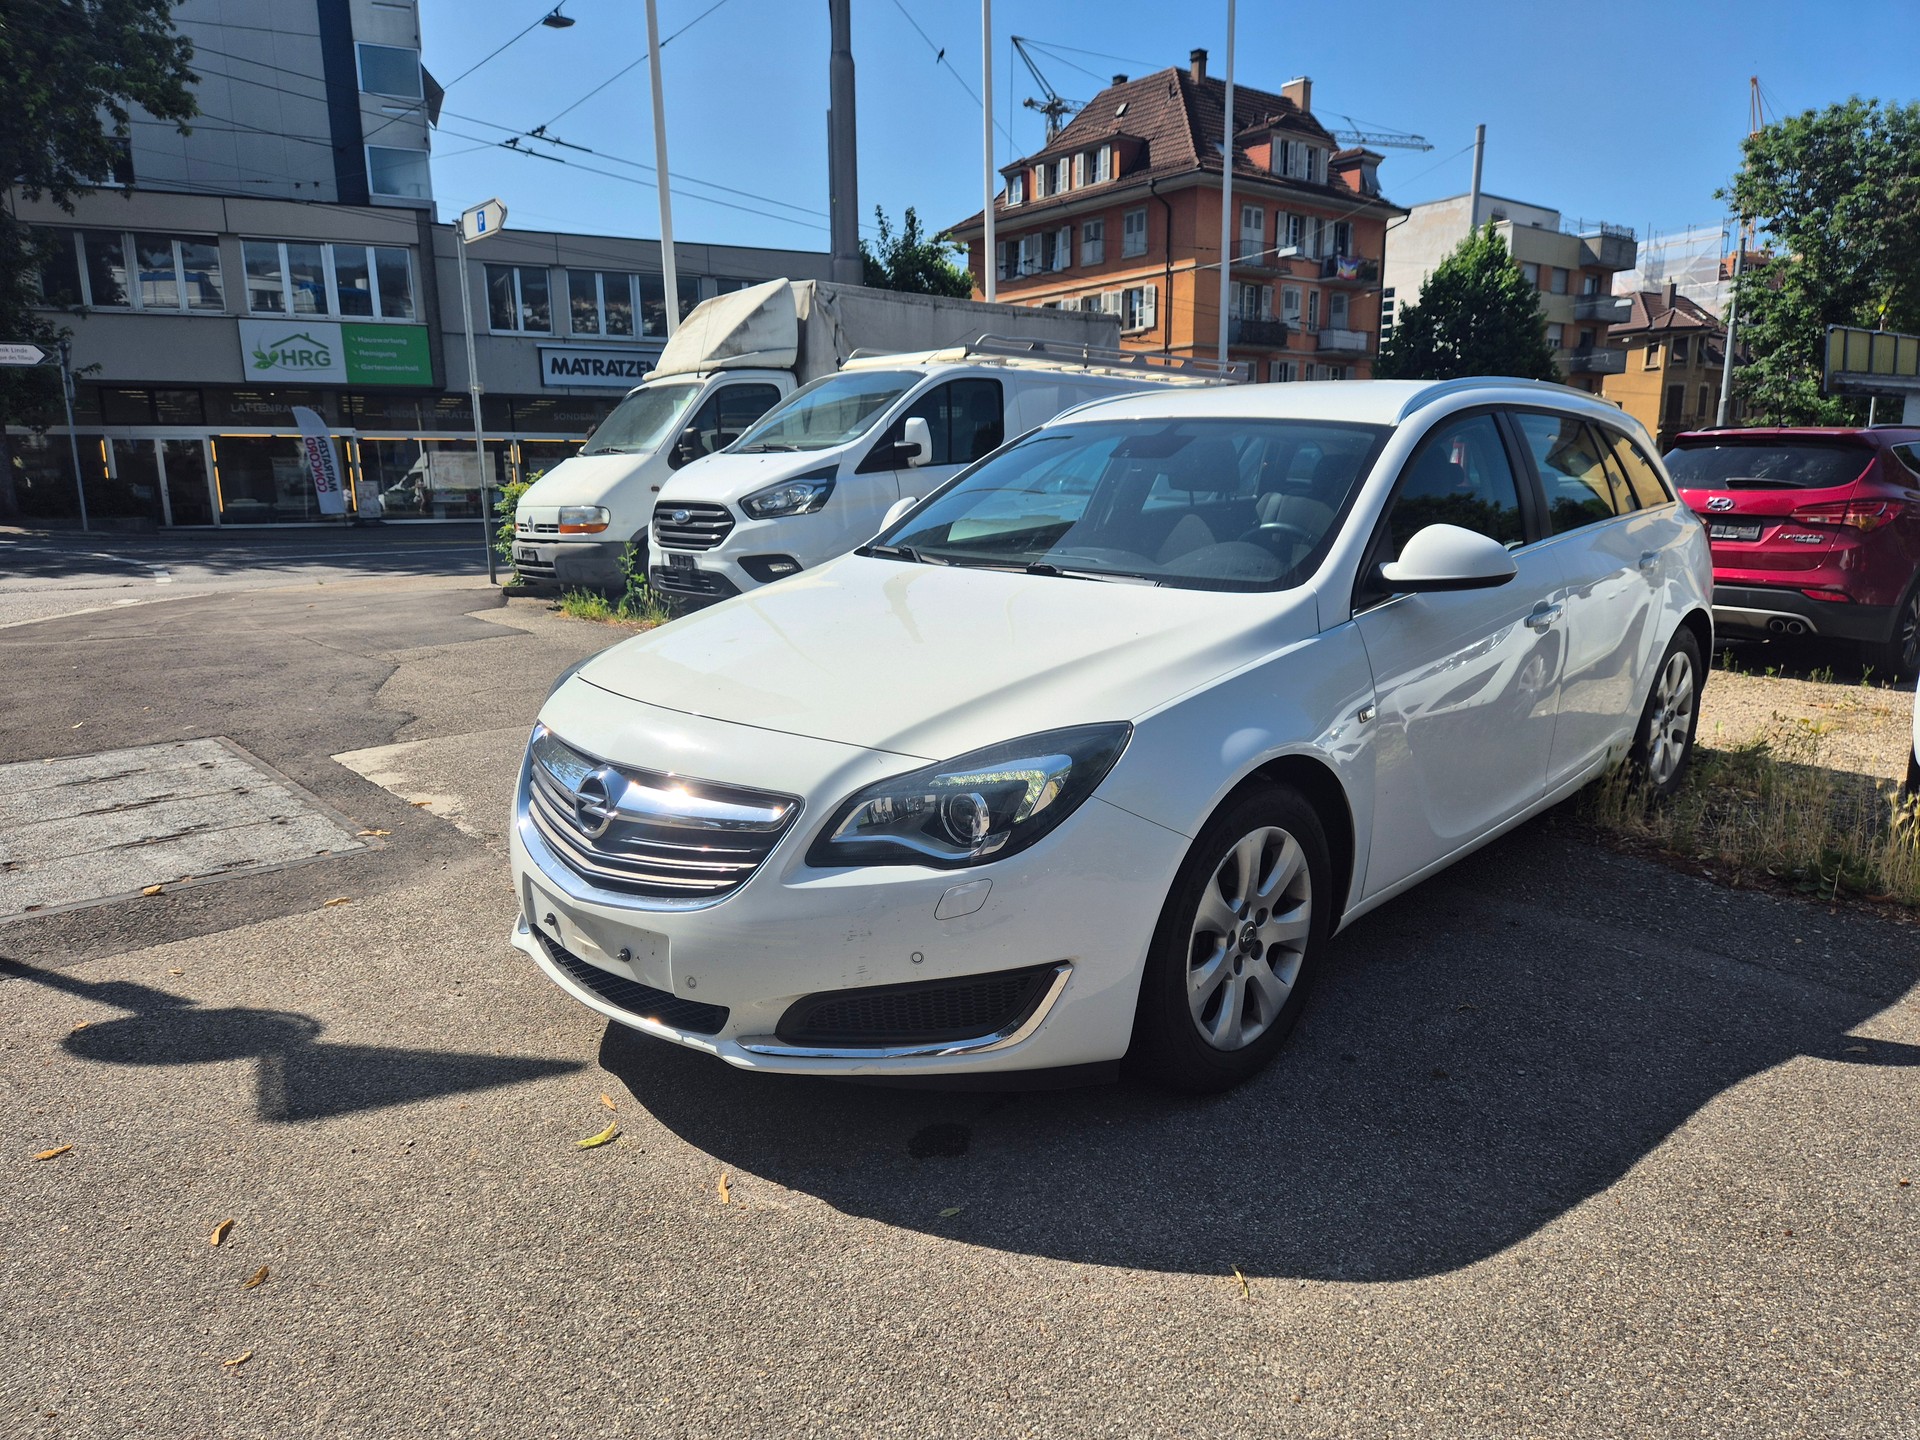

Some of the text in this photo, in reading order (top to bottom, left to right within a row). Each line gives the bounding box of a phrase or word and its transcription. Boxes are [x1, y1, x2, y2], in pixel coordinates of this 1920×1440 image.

[478, 213, 484, 230] P
[357, 336, 408, 346] Hauswartung
[281, 349, 331, 366] HRG
[361, 363, 419, 372] Gartenunterhalt
[230, 402, 328, 414] LATTENRAEN
[383, 409, 476, 420] KINDERMATRATZE
